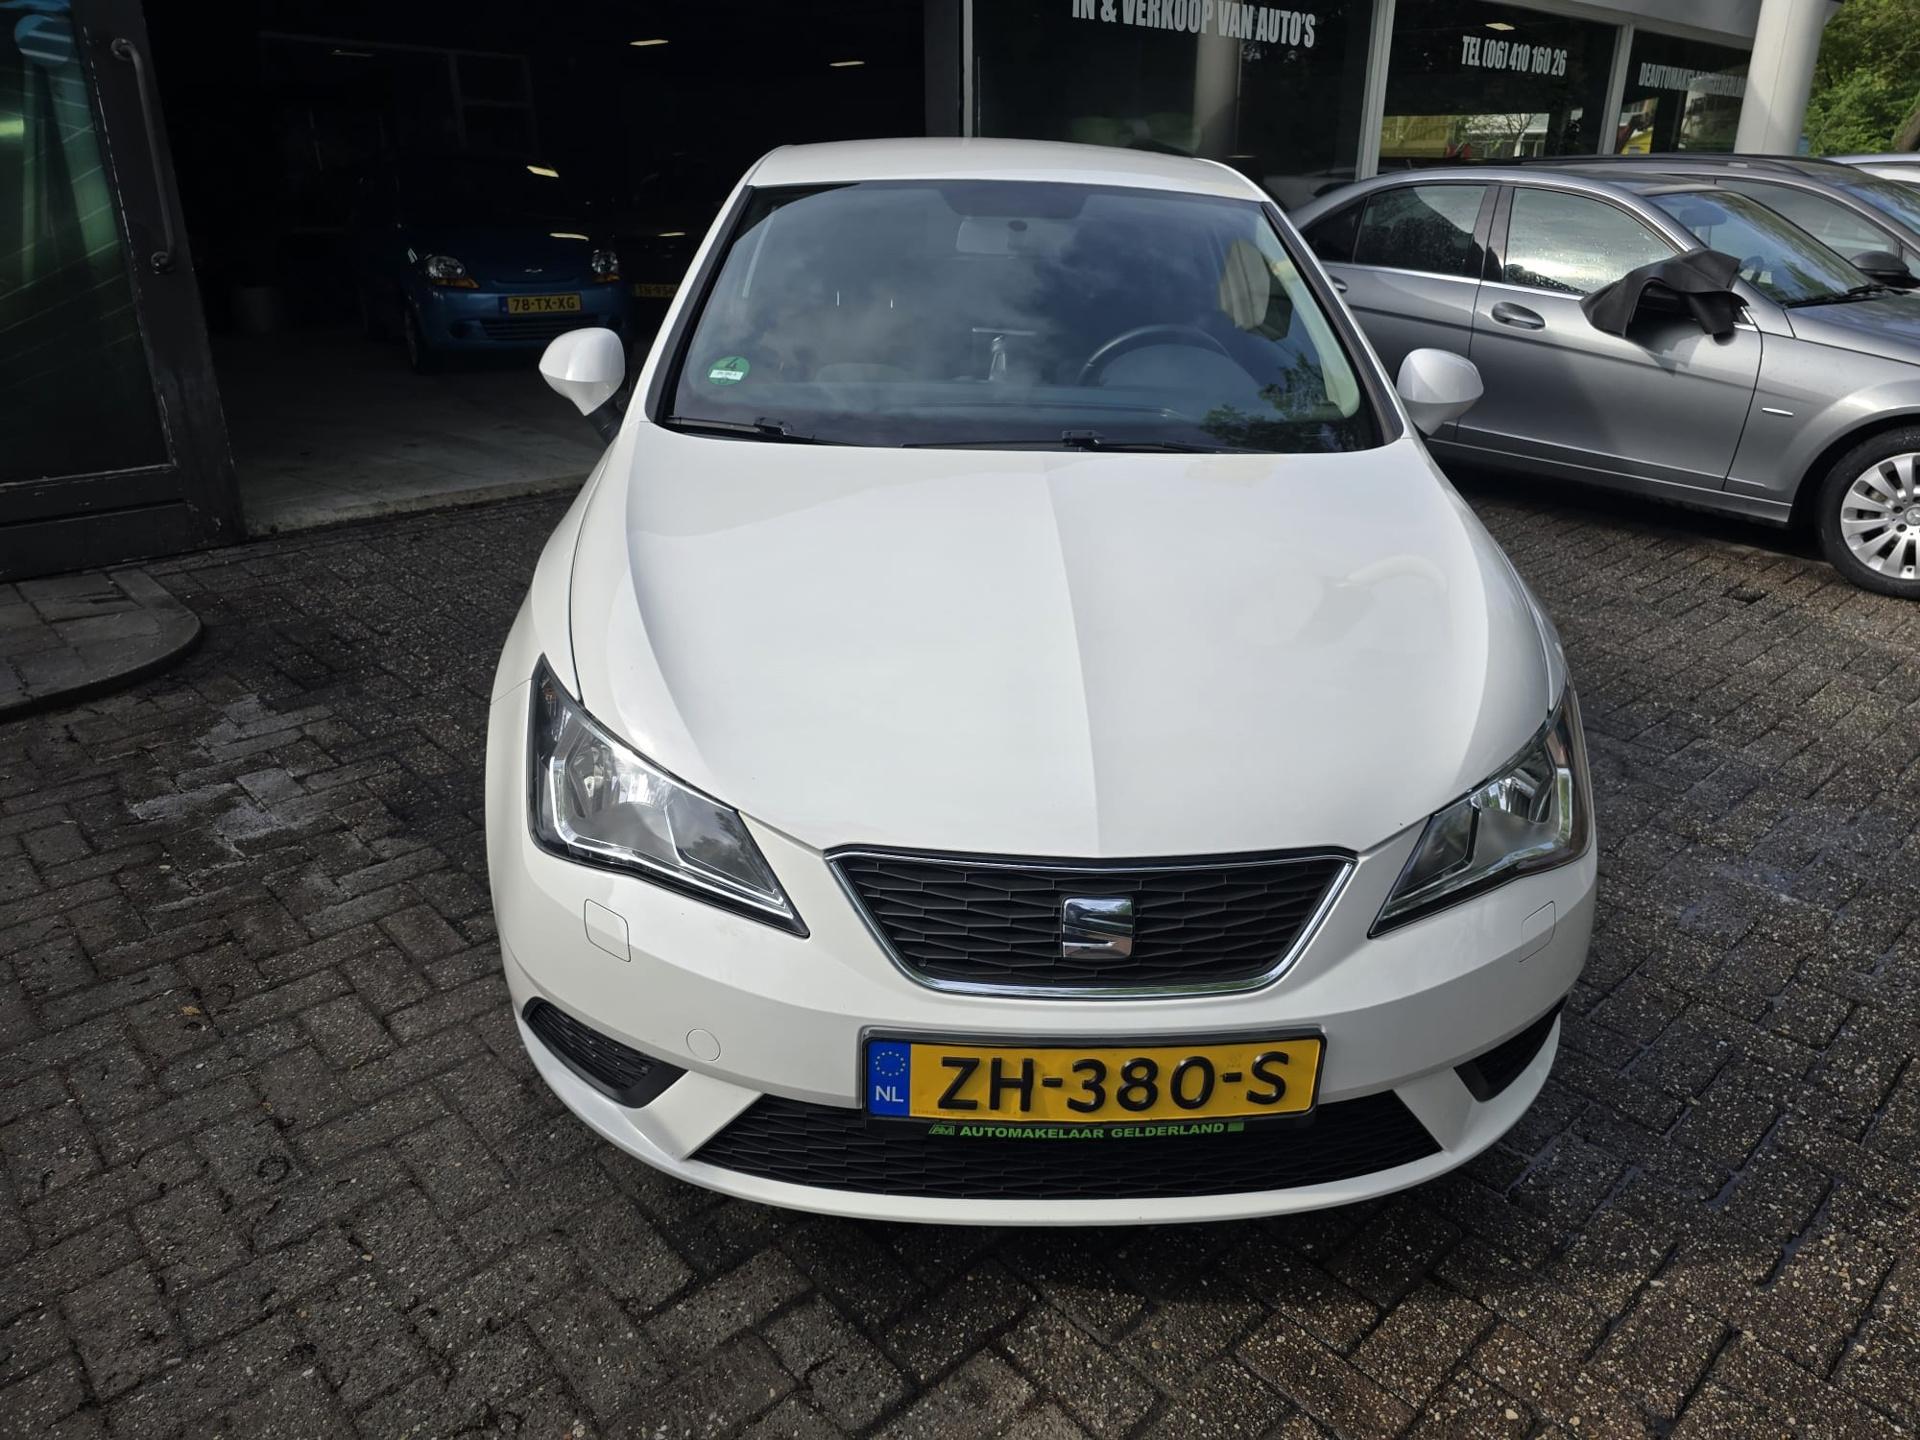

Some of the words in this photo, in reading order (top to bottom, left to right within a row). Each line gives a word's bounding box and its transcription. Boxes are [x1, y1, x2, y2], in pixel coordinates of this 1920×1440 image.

[1100, 0, 1118, 23] &
[1122, 0, 1213, 34] VERKOOP
[1218, 1, 1253, 40] VAN
[1256, 8, 1316, 48] AUTO'S
[1461, 35, 1480, 67] TEL
[1482, 38, 1509, 70] (06)
[1509, 42, 1530, 73] 410
[1531, 45, 1552, 75] 160
[1552, 49, 1567, 77] 26
[875, 1085, 904, 1103] NL
[937, 1051, 1289, 1112] ZH-380-S
[960, 1126, 1104, 1139] AUTOMAKELAAR
[1111, 1122, 1225, 1139] GELDERLAND
